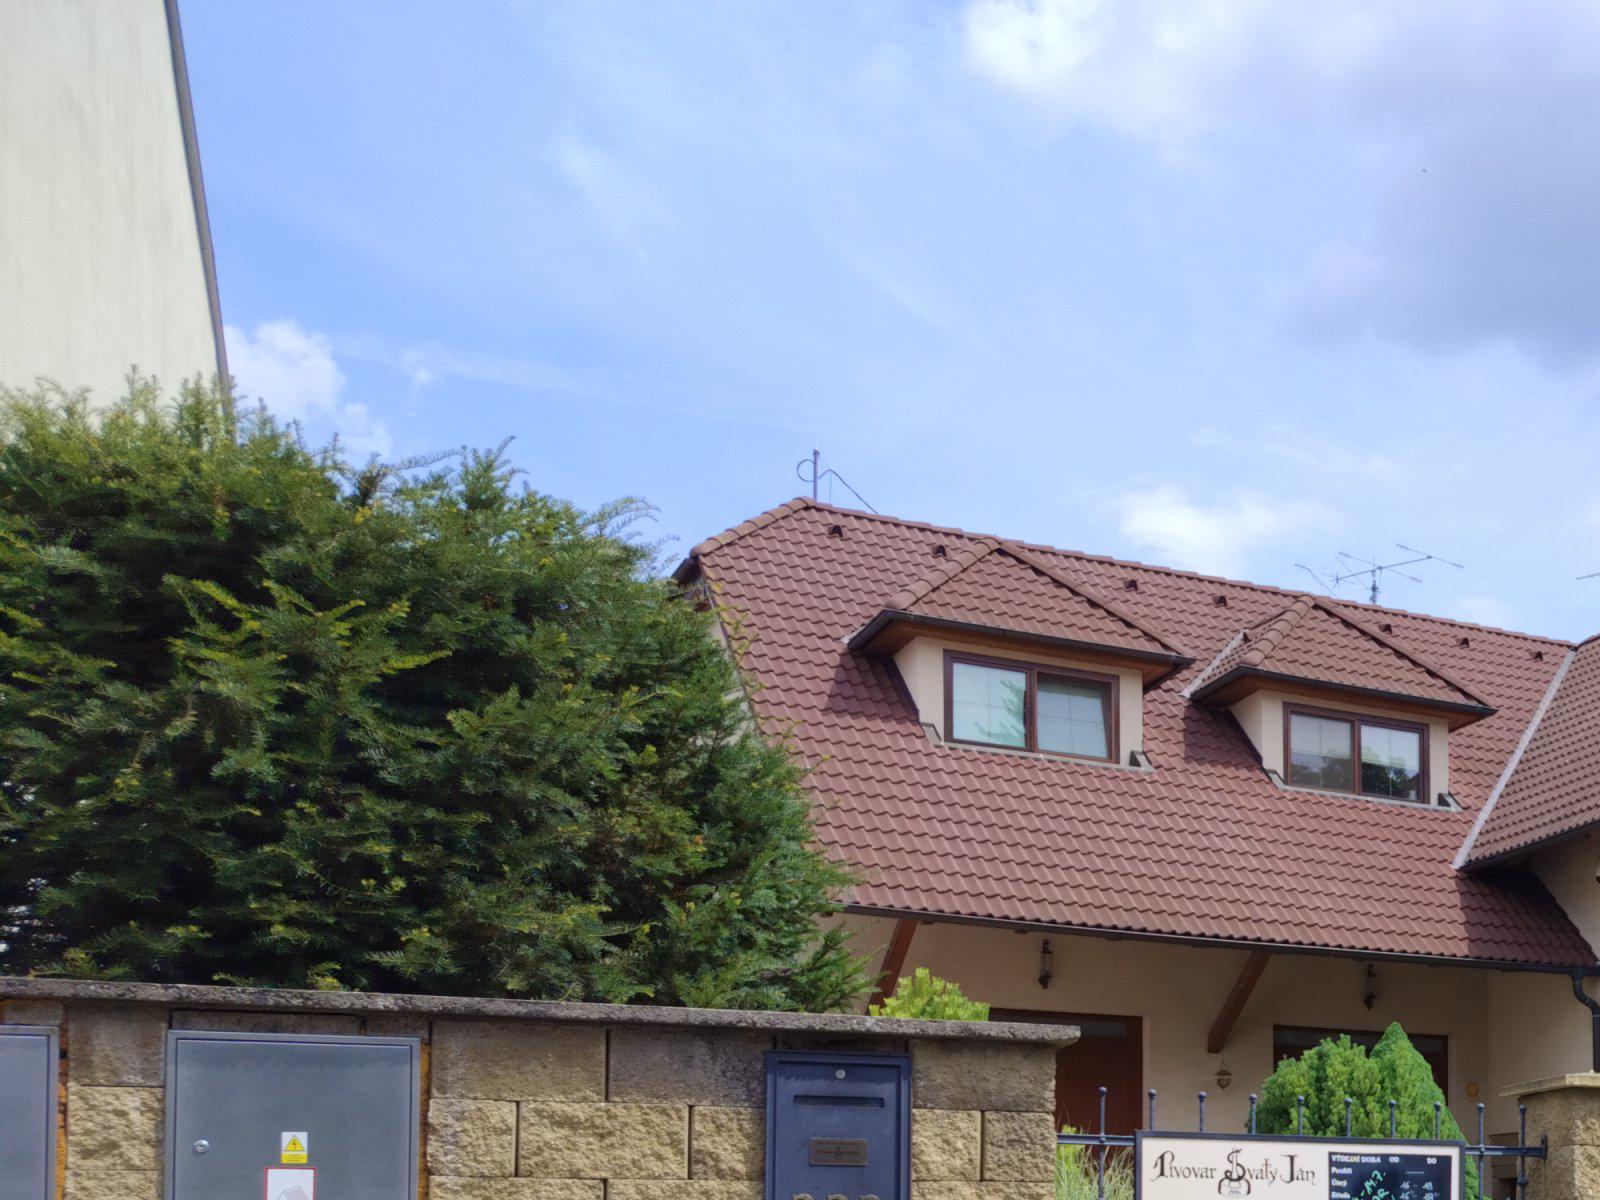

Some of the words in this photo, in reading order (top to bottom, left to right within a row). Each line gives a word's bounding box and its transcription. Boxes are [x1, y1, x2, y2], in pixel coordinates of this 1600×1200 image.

[1150, 1150, 1217, 1182] Pivovar
[1279, 1153, 1316, 1186] Ján
[1361, 1156, 1381, 1164] DOBA
[1389, 1156, 1400, 1164] OD
[1426, 1157, 1437, 1165] DO
